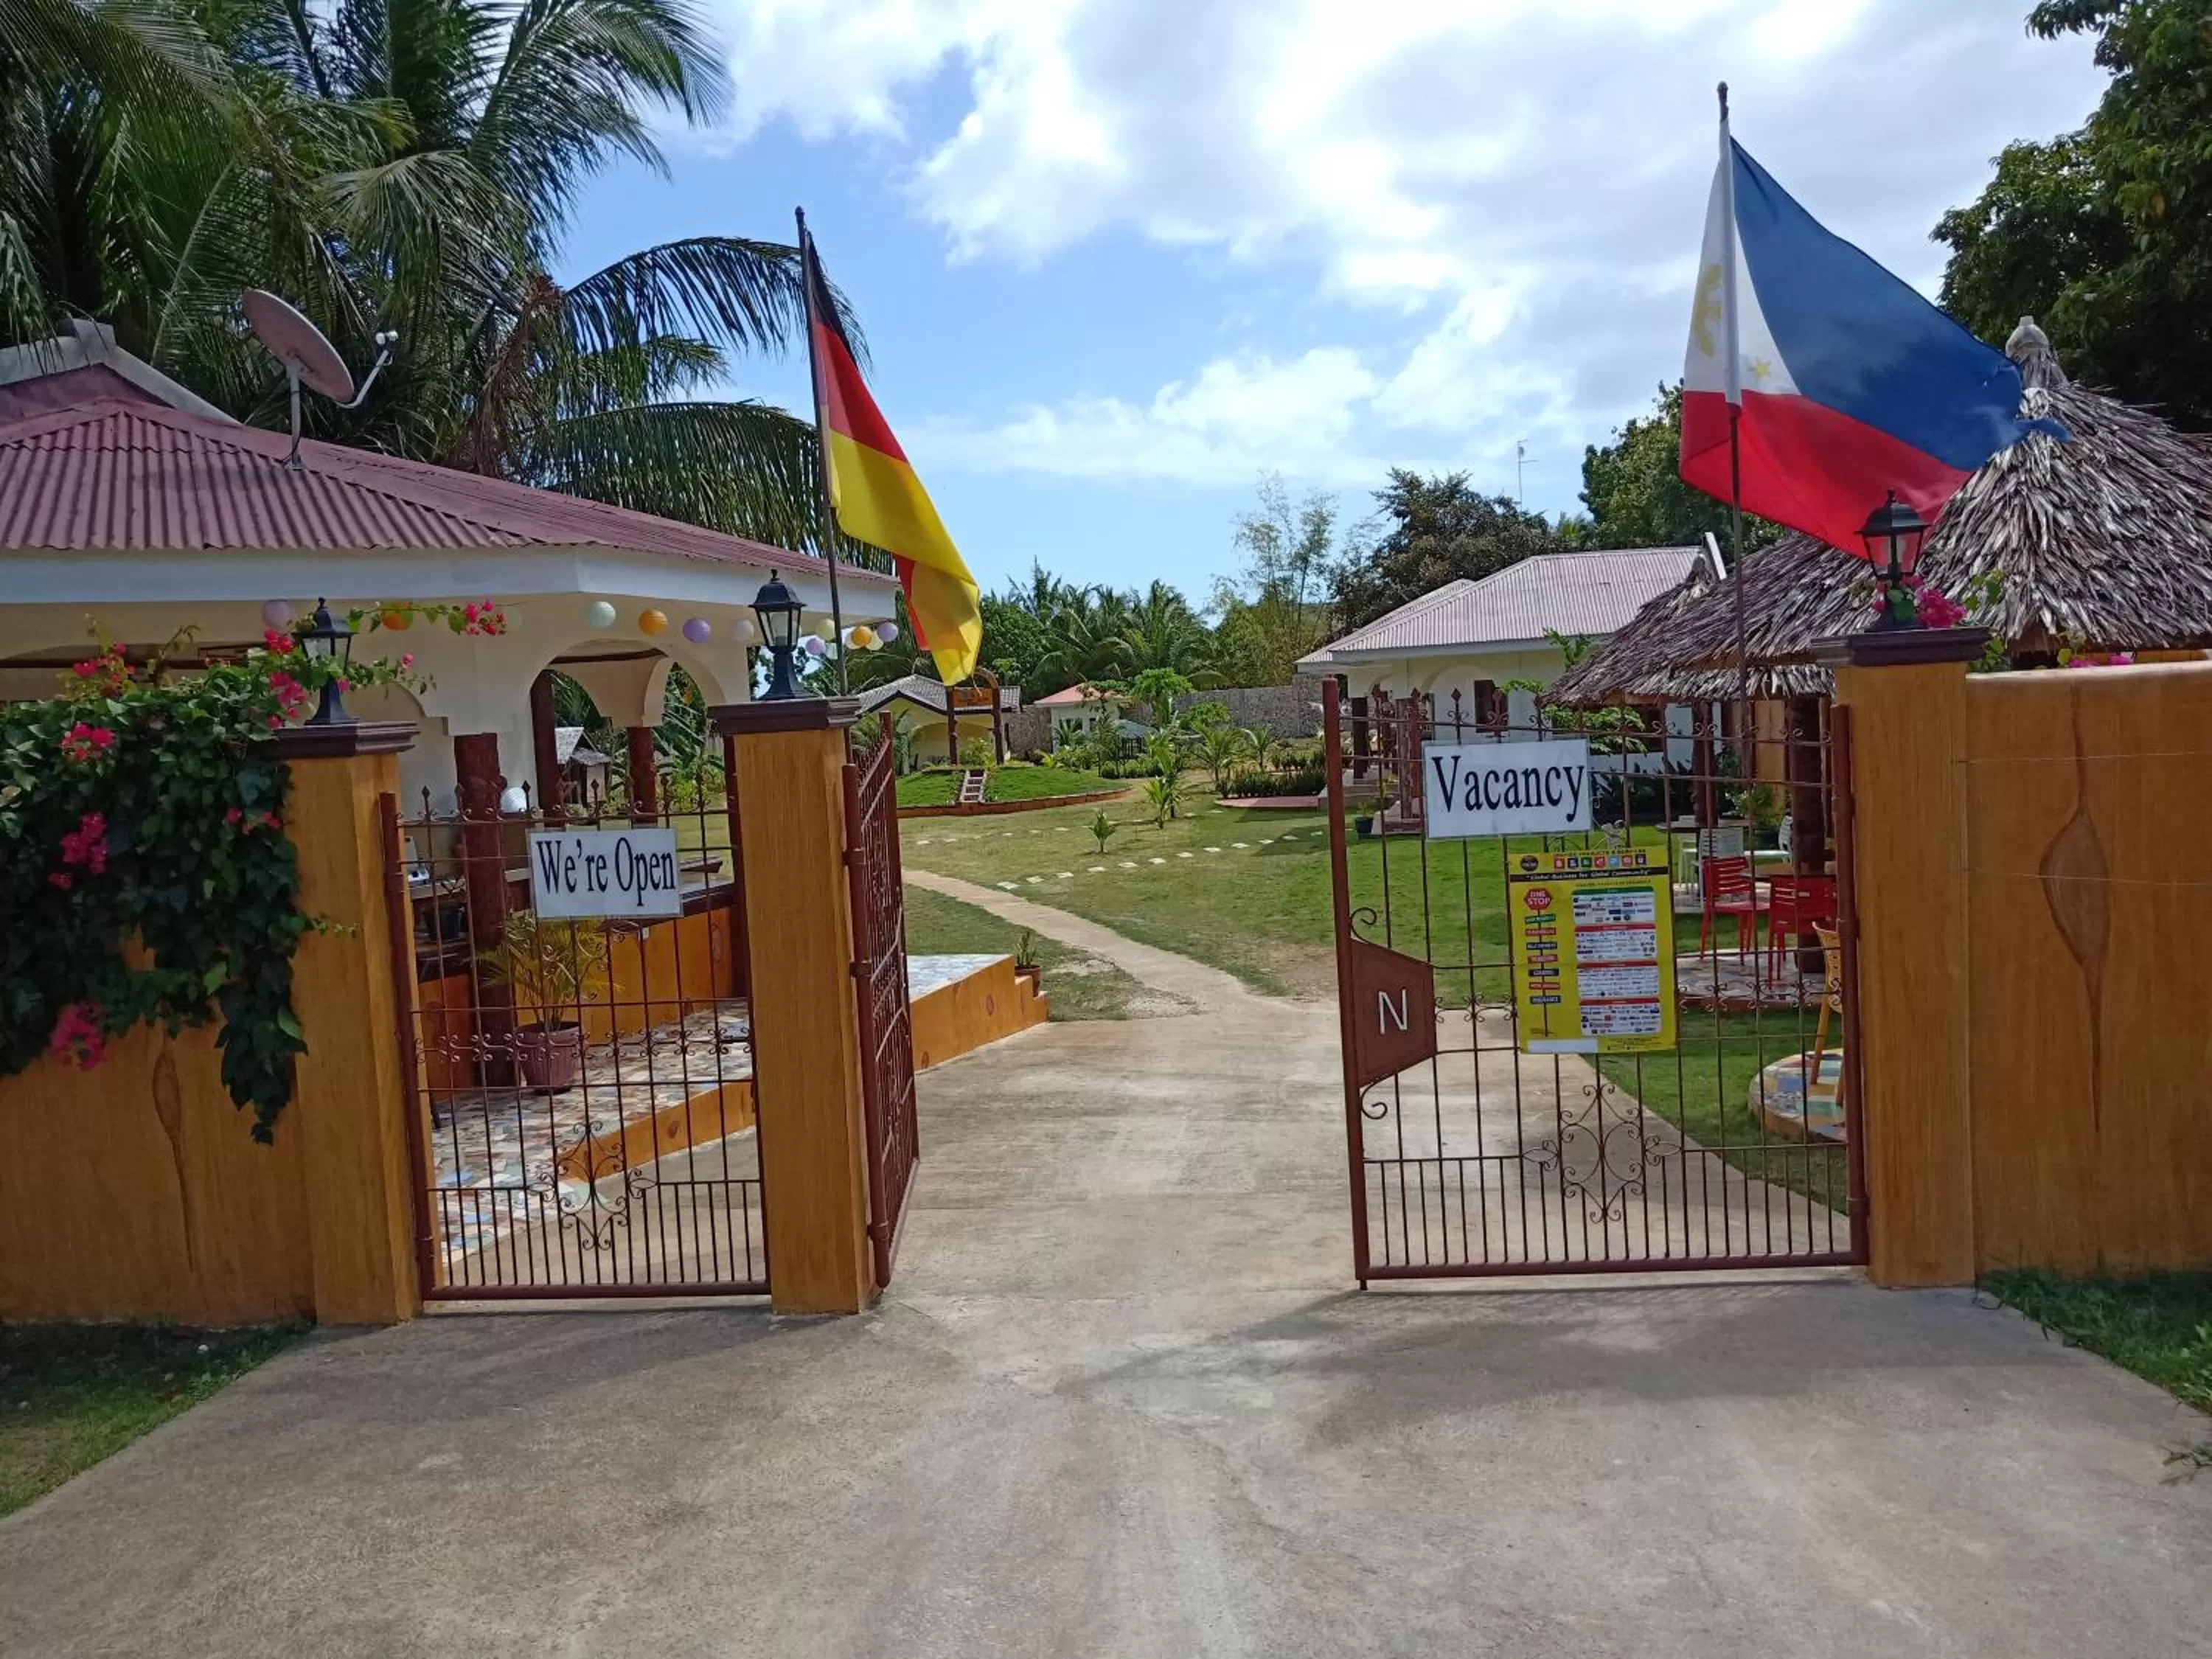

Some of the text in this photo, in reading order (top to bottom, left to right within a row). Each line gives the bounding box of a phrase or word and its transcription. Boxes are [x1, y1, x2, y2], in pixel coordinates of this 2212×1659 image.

[1431, 755, 1585, 823] Vacancy
[535, 837, 676, 907] We’re Open
[1528, 897, 1551, 905] STOP
[1378, 989, 1408, 1035] N
